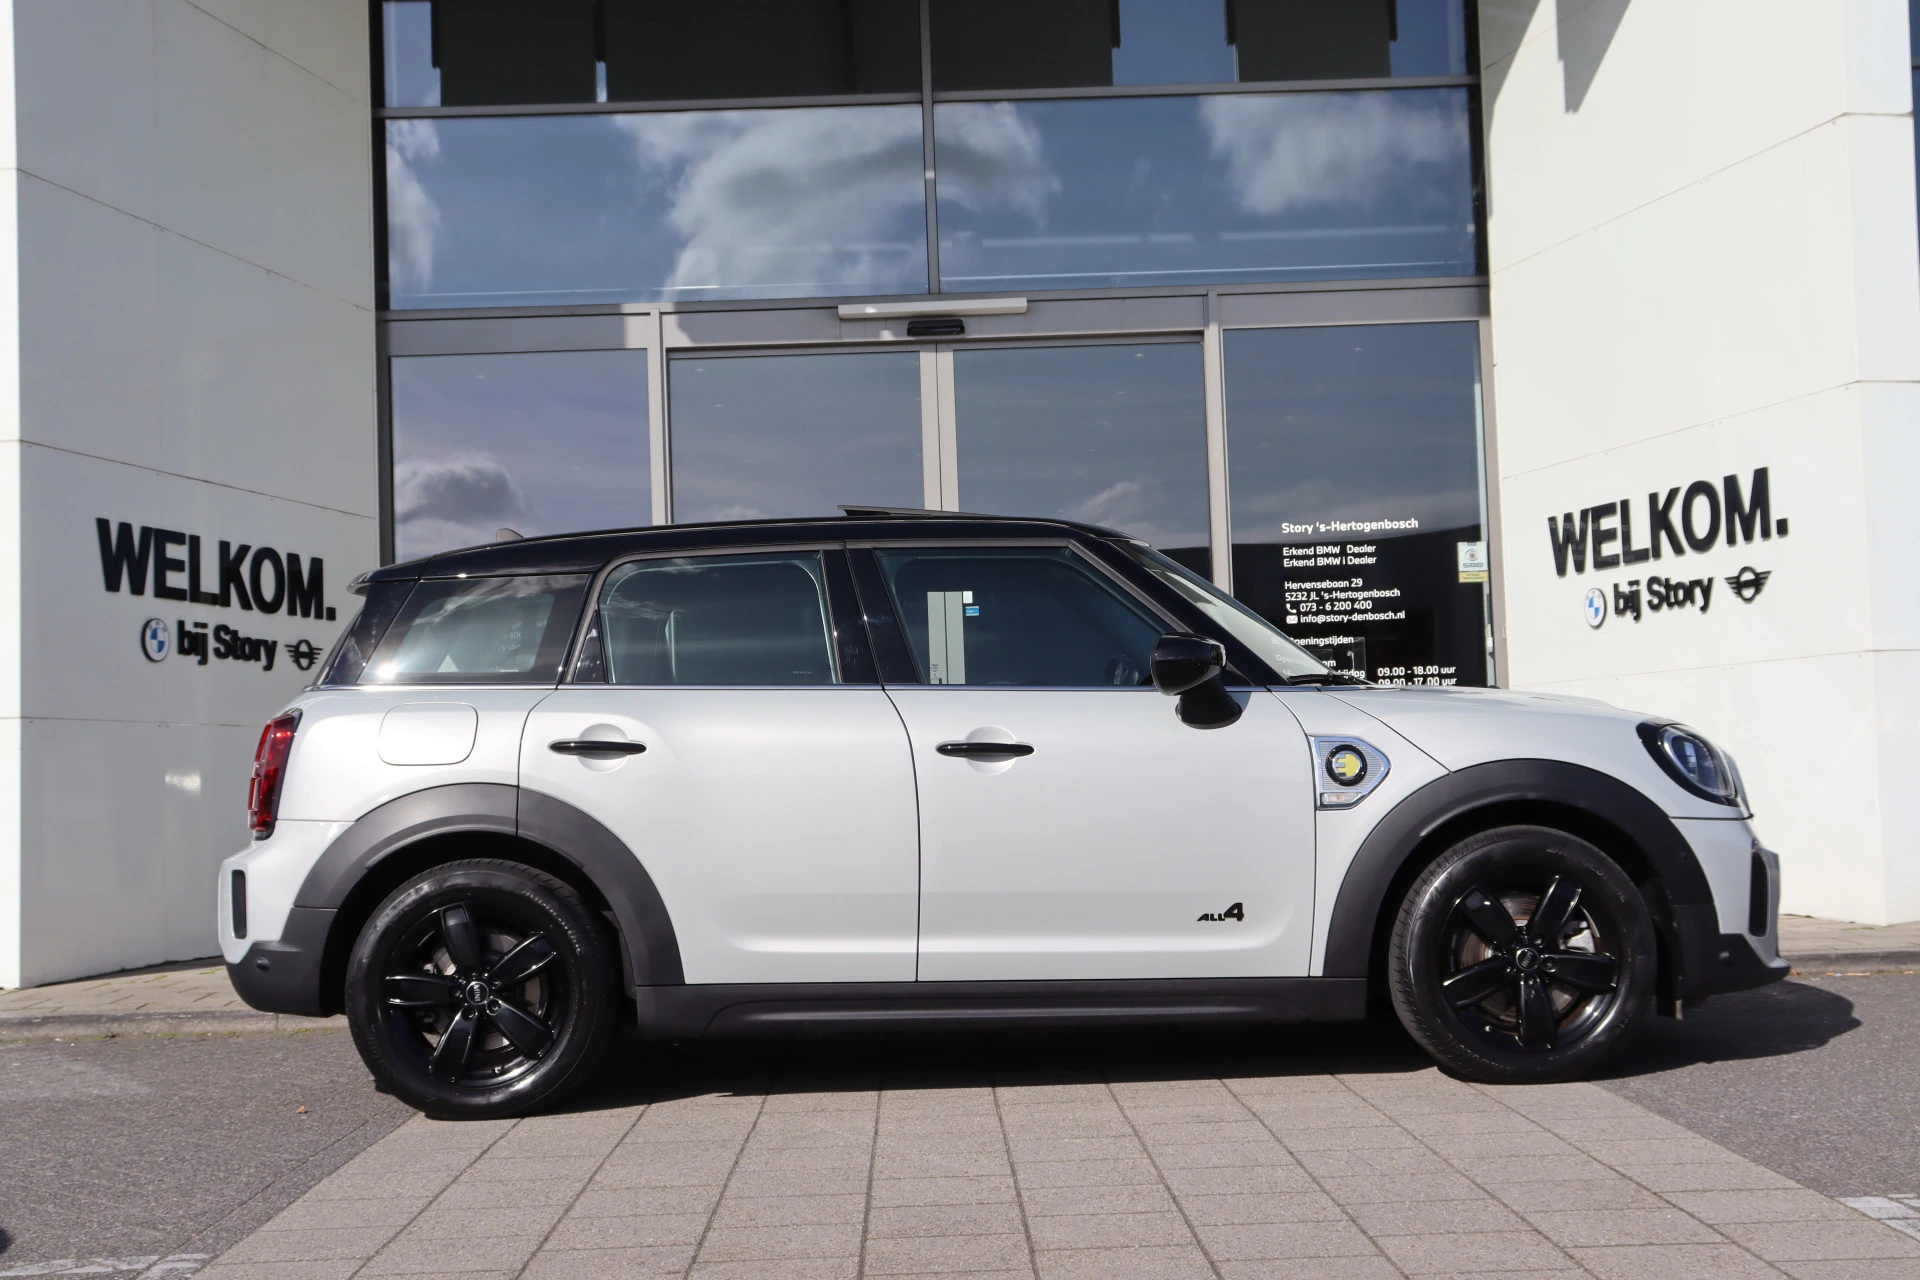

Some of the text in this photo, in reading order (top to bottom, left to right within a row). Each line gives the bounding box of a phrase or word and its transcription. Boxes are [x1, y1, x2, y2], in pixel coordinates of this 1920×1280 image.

[1282, 518, 1419, 534] Story 's-Hertogenbosch
[1548, 466, 1789, 577] WELKOM.
[1283, 544, 1376, 556] Erkend BMW Dealer
[1284, 556, 1377, 567] Erkend BMW i Dealer
[96, 517, 336, 621] WELKOM.
[1285, 579, 1363, 590] Hervensebaan 29
[1285, 588, 1400, 601] 5232 JL 's-Hertogenbosch
[1613, 576, 1714, 623] bij Story
[1300, 602, 1317, 611] 073
[1325, 602, 1331, 610] 6
[1334, 602, 1351, 610] 200
[1354, 601, 1372, 609] 400
[1300, 611, 1405, 624] info@story-denbosch.nl
[177, 620, 277, 671] bij Story
[1377, 667, 1405, 676] 09.00
[1413, 666, 1439, 675] 18.00
[1197, 902, 1244, 922] ALL4
